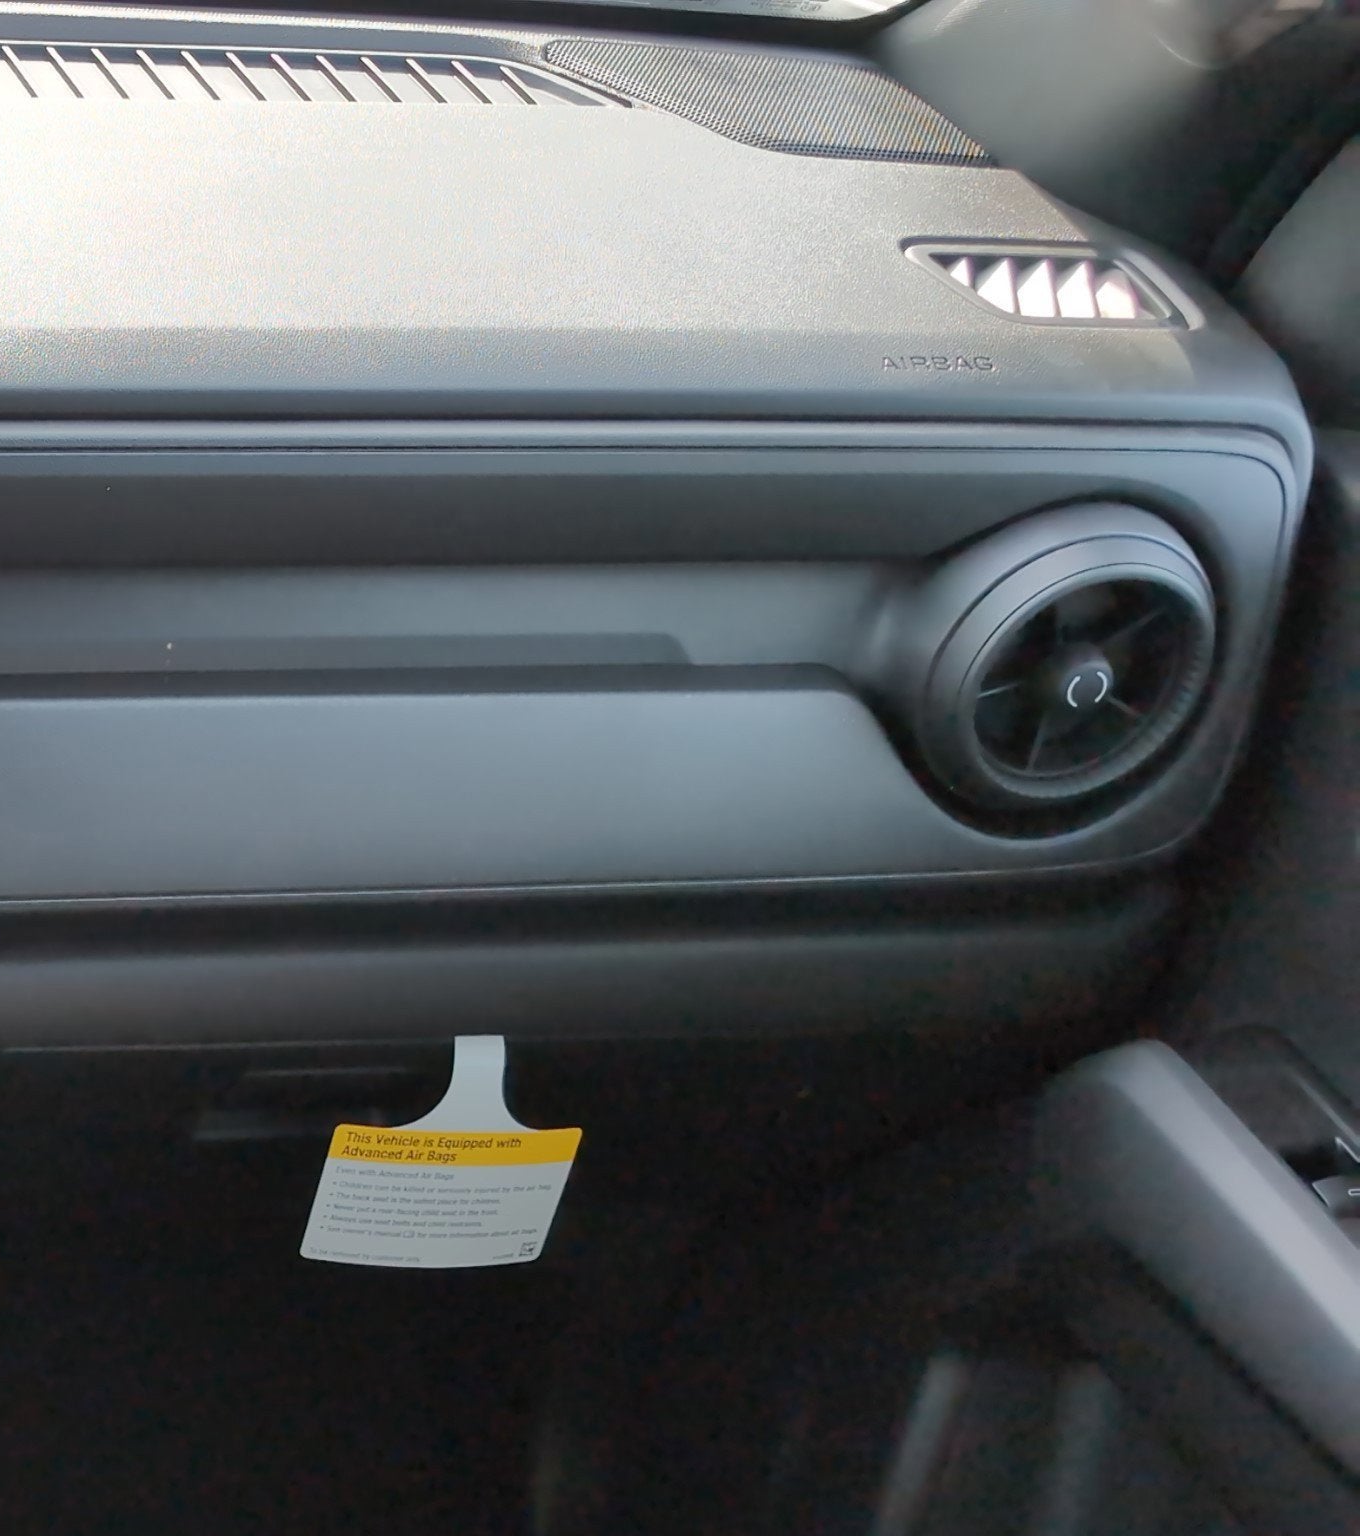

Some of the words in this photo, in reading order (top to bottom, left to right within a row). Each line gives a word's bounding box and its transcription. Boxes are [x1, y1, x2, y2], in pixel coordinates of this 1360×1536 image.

[882, 356, 994, 371] AIRBAG
[346, 1131, 372, 1145] This
[376, 1134, 420, 1148] Vehicle
[422, 1137, 435, 1149] is
[437, 1137, 494, 1152] Equipped
[496, 1138, 522, 1150] with
[342, 1145, 403, 1161] Advanced
[405, 1149, 424, 1161] Air
[426, 1150, 458, 1165] Bags
